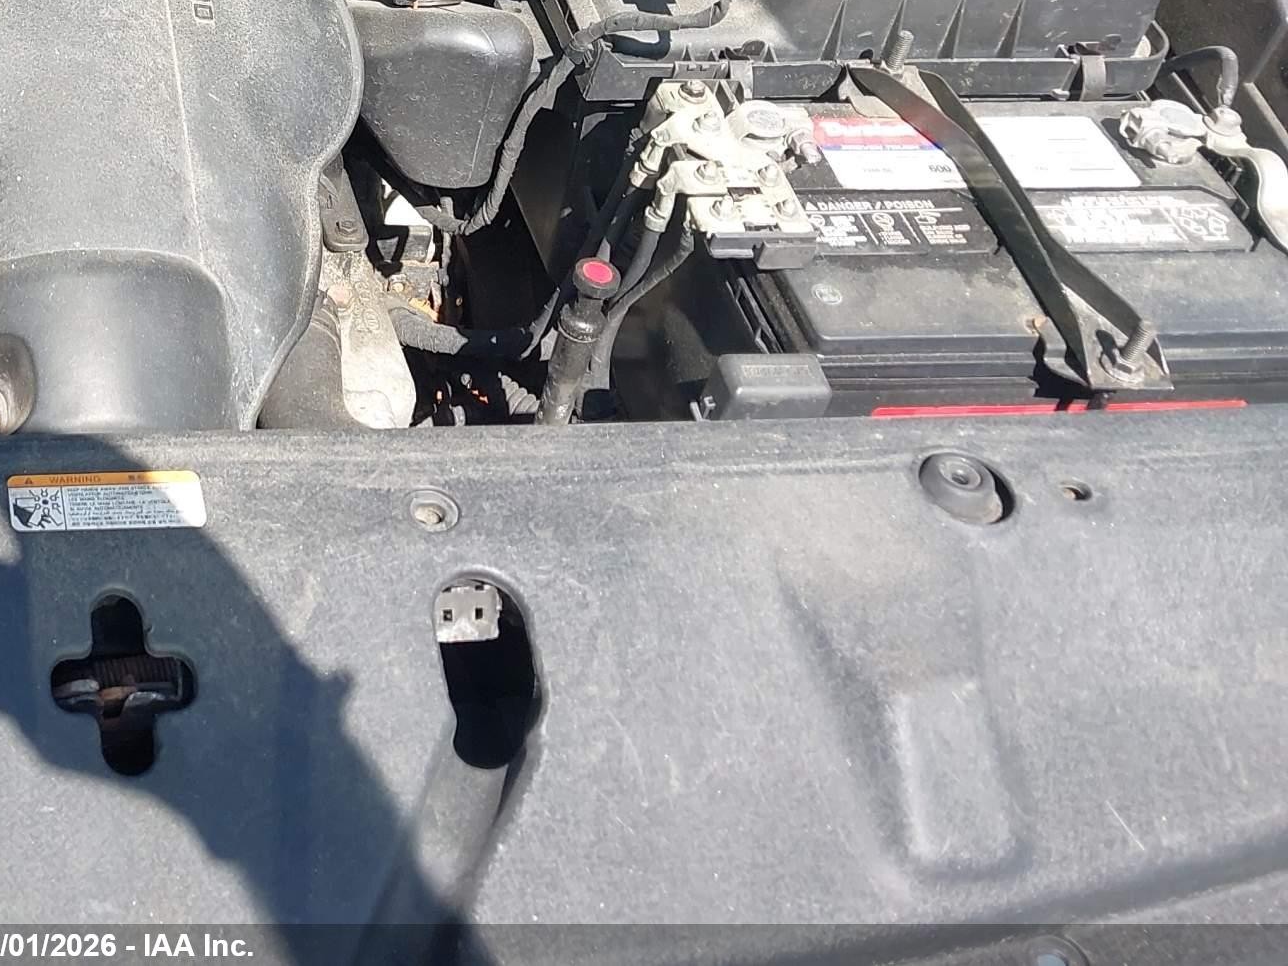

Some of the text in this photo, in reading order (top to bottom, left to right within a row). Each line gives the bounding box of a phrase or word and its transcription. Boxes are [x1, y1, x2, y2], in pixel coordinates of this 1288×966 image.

[816, 201, 873, 211] DANGER
[883, 199, 936, 210] POISON
[48, 475, 102, 485] WARNING
